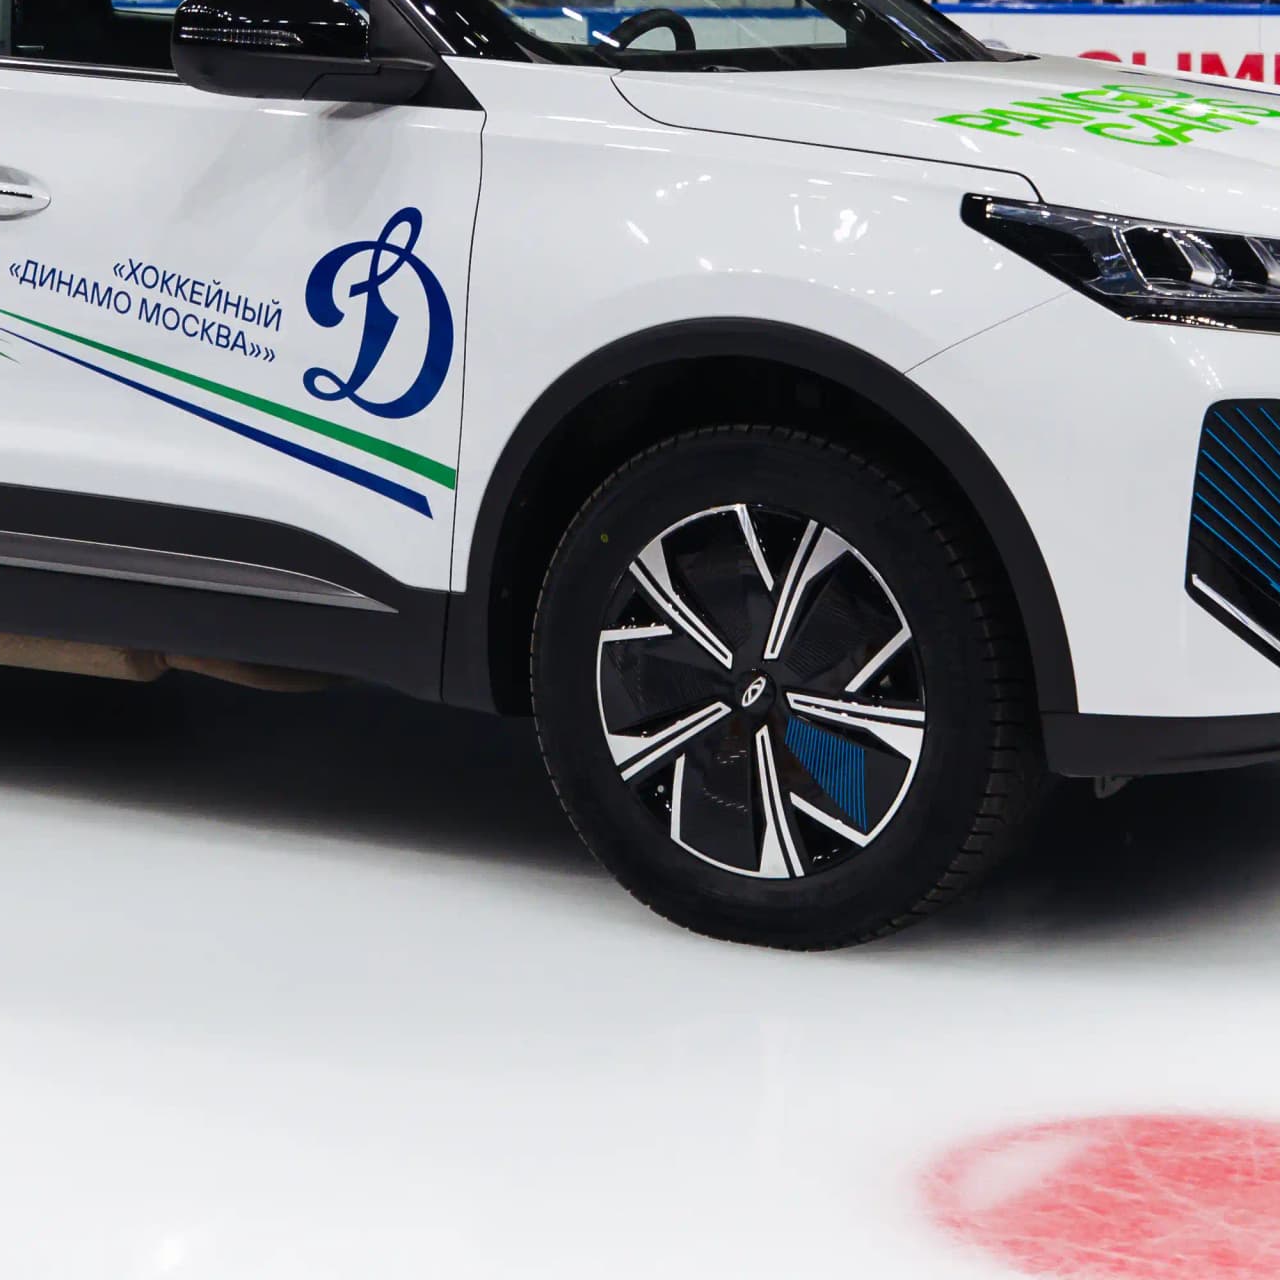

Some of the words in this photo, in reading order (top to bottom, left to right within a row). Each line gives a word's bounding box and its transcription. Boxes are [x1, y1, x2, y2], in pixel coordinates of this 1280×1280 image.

[934, 84, 1192, 138] PANGO
[8, 258, 132, 316] «ДИНАМО
[138, 300, 276, 363] МОСКВА»»
[112, 257, 284, 333] «ХОККЕЙНЫЙ
